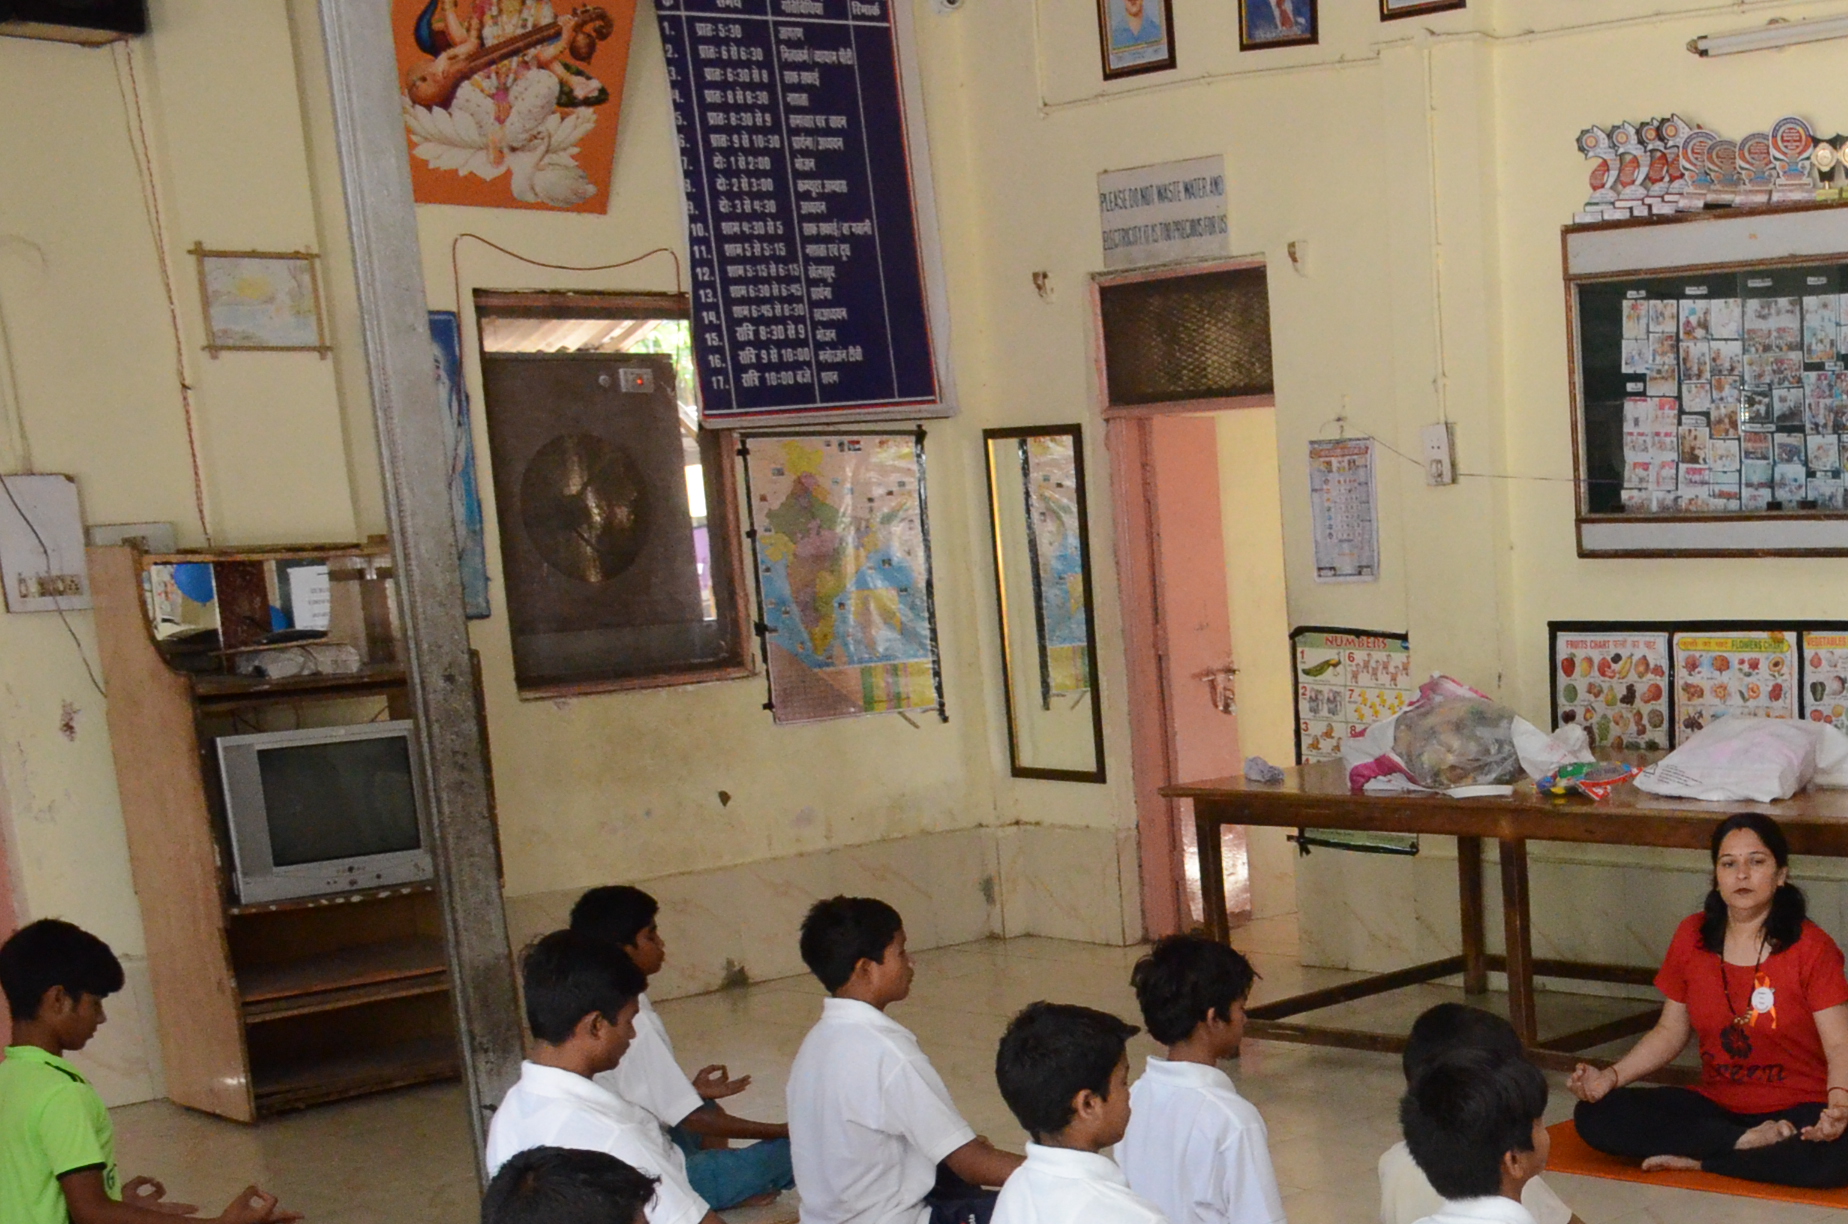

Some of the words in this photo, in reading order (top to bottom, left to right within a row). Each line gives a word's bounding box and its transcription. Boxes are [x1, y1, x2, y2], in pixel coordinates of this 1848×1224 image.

[1325, 636, 1387, 649] NUMBERS
[1566, 640, 1588, 649] FRUITS
[1590, 640, 1610, 649] CHART
[1732, 640, 1762, 651] FLOWERS
[1807, 636, 1848, 647] VEGETABLES
[1300, 650, 1305, 659] 1
[1348, 652, 1355, 662] 6
[1301, 686, 1307, 696] 2
[1348, 689, 1354, 699] 7
[1302, 722, 1309, 732] 3
[1350, 725, 1356, 735] 8
